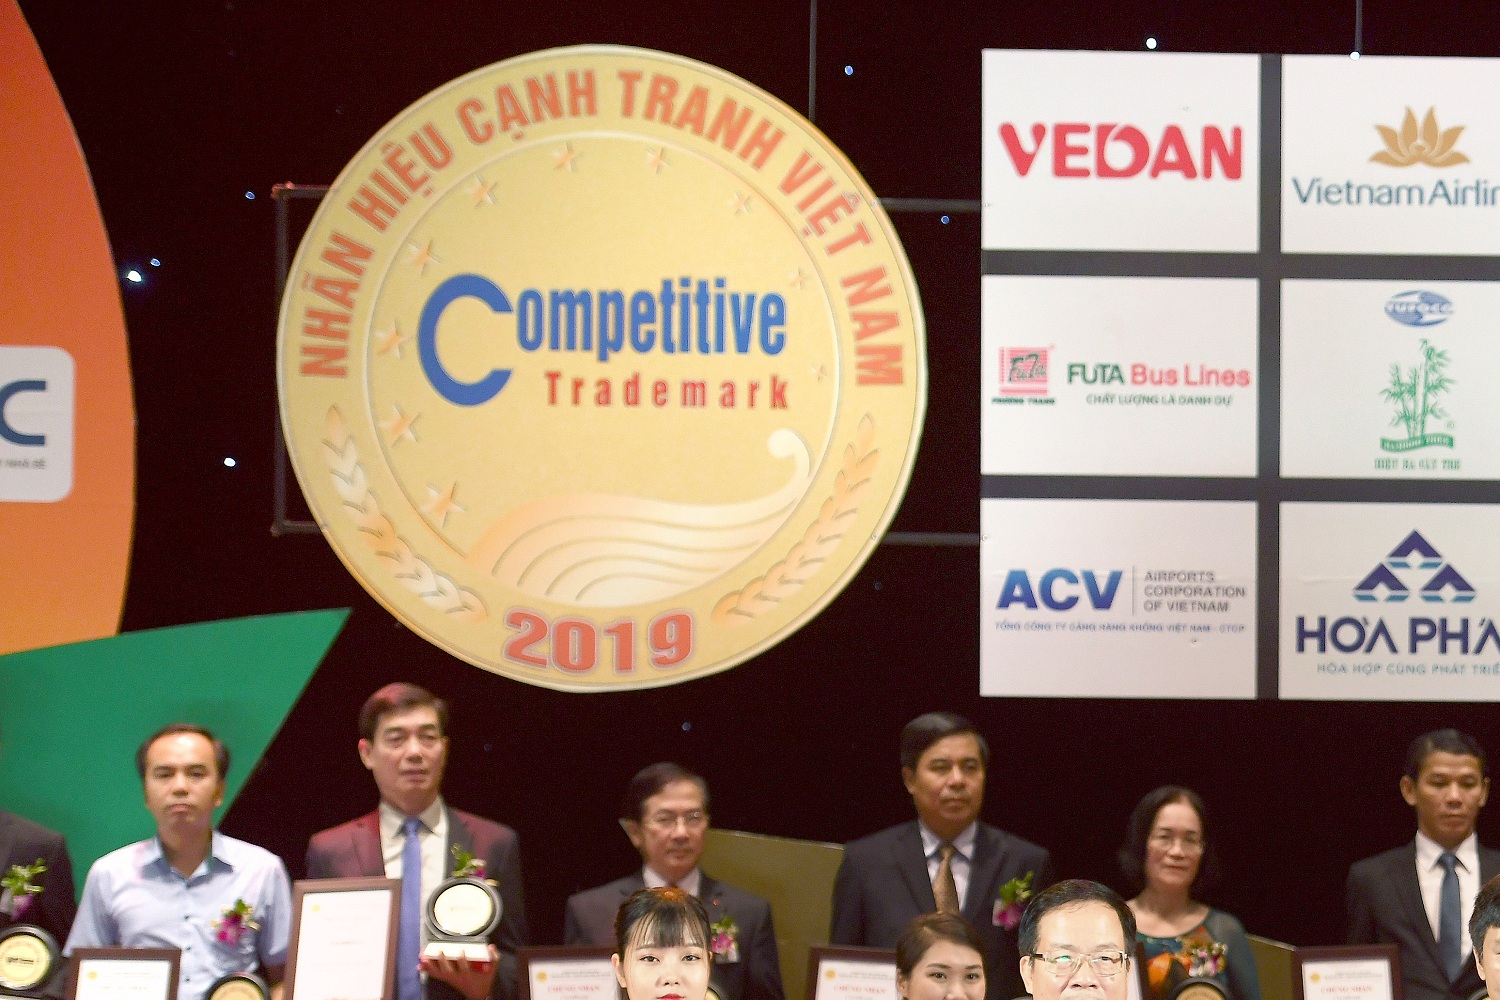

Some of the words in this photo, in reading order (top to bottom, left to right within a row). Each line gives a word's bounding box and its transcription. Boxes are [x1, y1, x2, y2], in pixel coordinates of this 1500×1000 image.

[998, 122, 1243, 181] VEDAN
[1292, 176, 1425, 207] Vietnam
[300, 234, 373, 378] NHÃN
[346, 129, 453, 233] HIỆU
[455, 69, 599, 147] CẠNH
[616, 70, 786, 171] TRANH
[780, 150, 874, 256] VIỆT
[841, 266, 904, 387] NAM
[417, 273, 787, 407] Competitive
[545, 371, 789, 410] Trademark
[1067, 363, 1124, 385] FUTA
[1130, 363, 1178, 386] Bus
[1184, 363, 1251, 387] Lines
[996, 568, 1124, 611] ACV
[1143, 570, 1215, 583] AIRPORTS
[1143, 585, 1246, 598] CORPORATION
[1143, 601, 1161, 612] OF
[1166, 601, 1229, 613] VIETNAM
[504, 610, 694, 674] 2019
